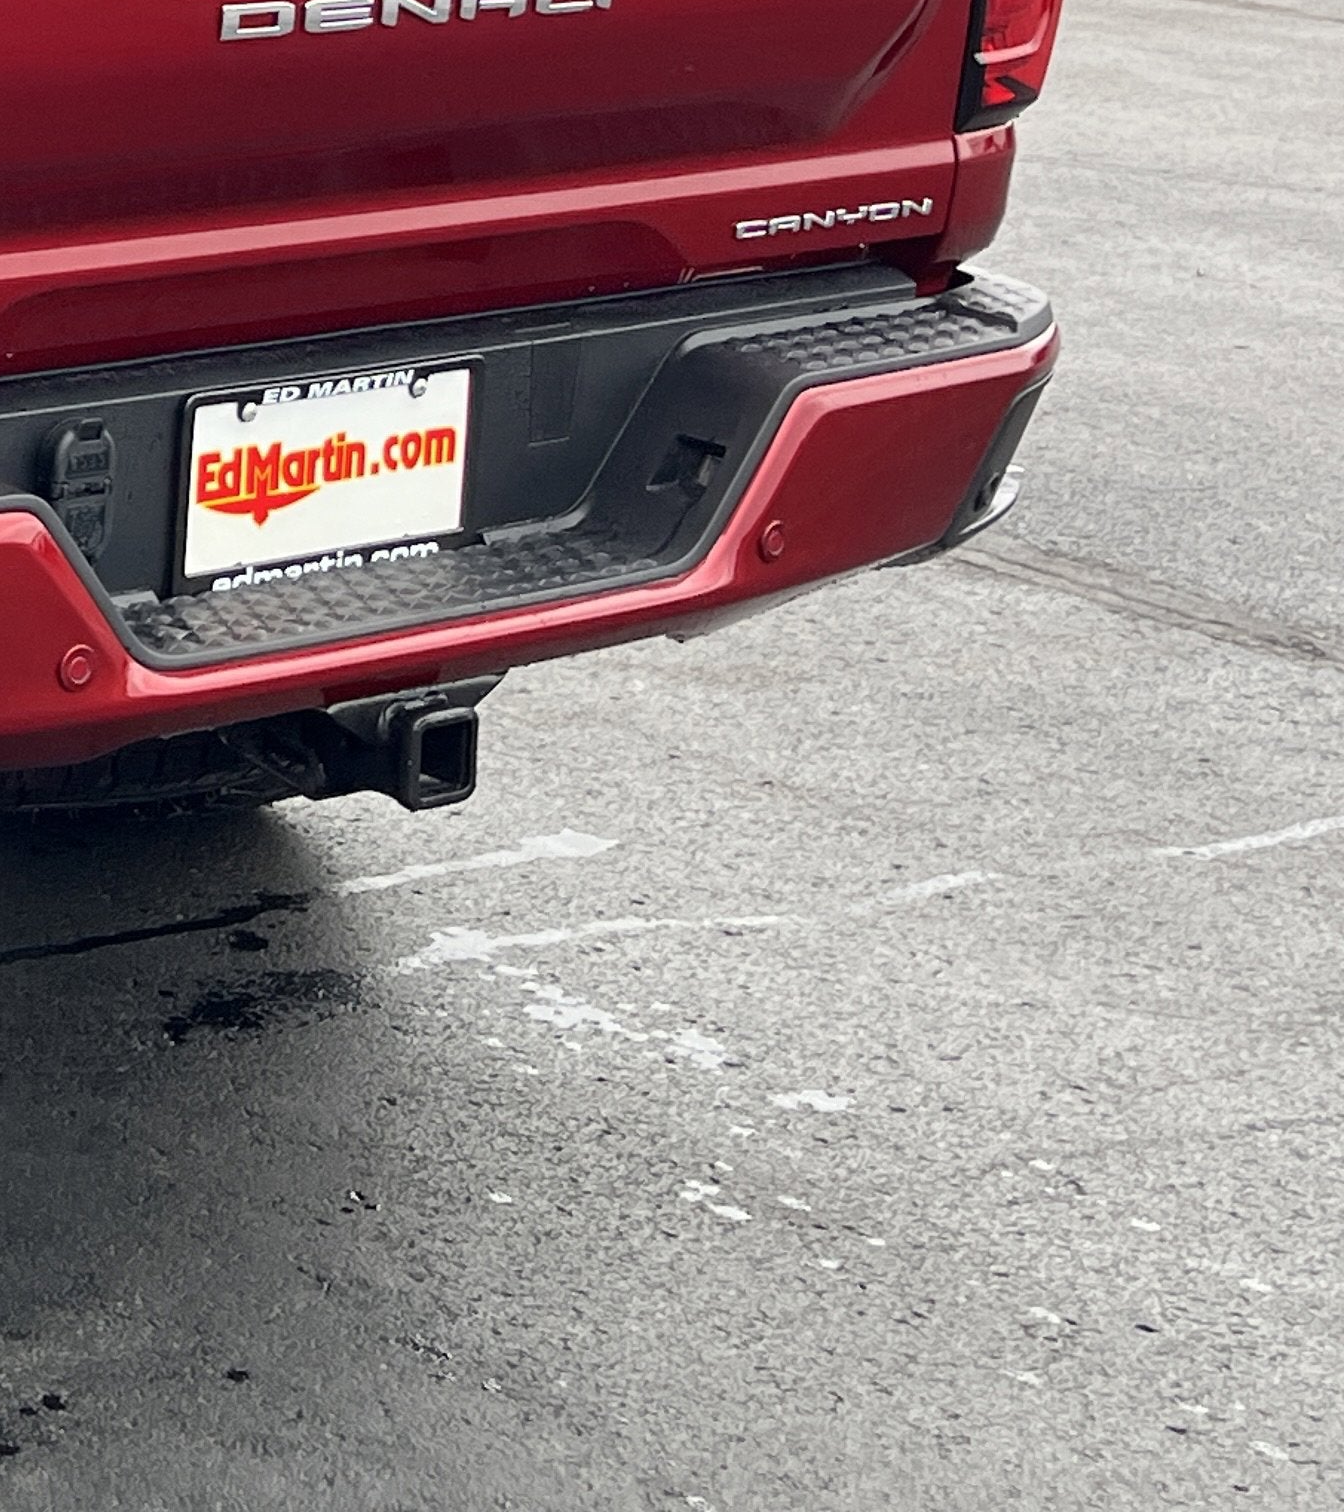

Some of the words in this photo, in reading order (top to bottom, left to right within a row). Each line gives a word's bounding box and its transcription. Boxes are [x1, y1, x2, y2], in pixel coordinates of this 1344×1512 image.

[735, 197, 933, 239] CANYON
[262, 386, 300, 405] ED
[307, 369, 415, 399] MARTIN
